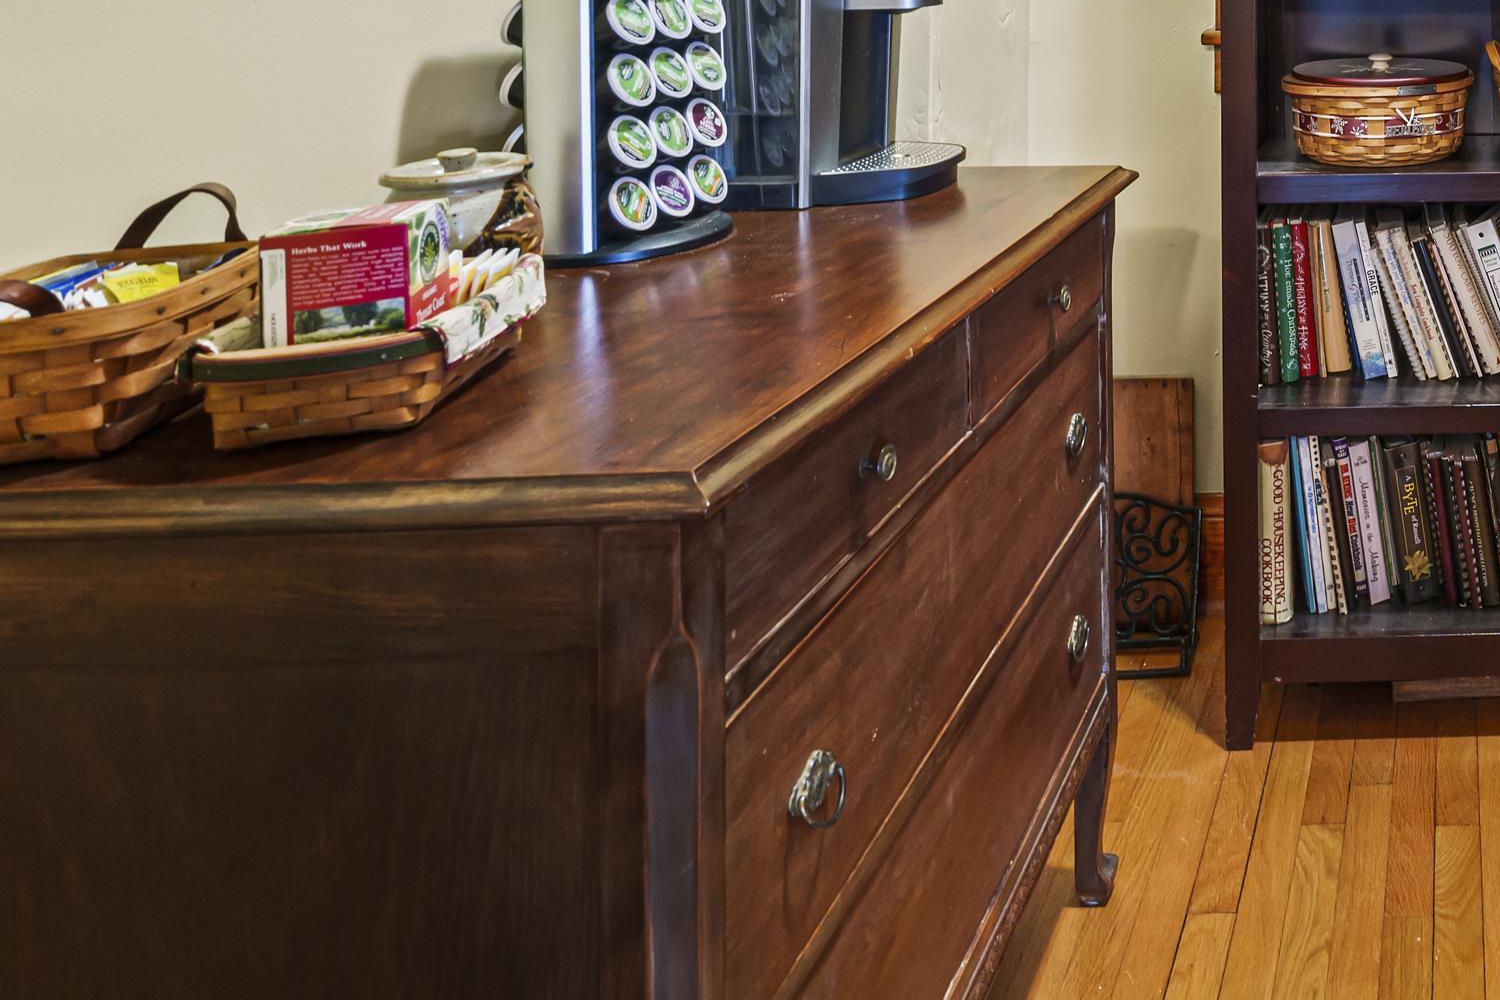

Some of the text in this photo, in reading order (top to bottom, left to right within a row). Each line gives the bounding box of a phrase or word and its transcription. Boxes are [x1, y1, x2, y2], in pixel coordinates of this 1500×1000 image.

[291, 240, 367, 255] Herbs That Work
[1366, 268, 1379, 296] GRACE
[1286, 309, 1297, 355] Christmas
[1410, 282, 1434, 341] New Complete Cookbook
[1339, 463, 1349, 475] DR.
[1344, 500, 1355, 518] New
[1347, 517, 1357, 533] Diet
[1358, 477, 1372, 520] Memories
[1367, 547, 1381, 582] Making
[1399, 481, 1419, 515] BYTE
[1411, 522, 1421, 544] Russell
[1272, 469, 1285, 605] GOOD HOUSEKEEPING
[1349, 534, 1363, 570] Cookbook
[1261, 538, 1272, 605] COOKBOOK
